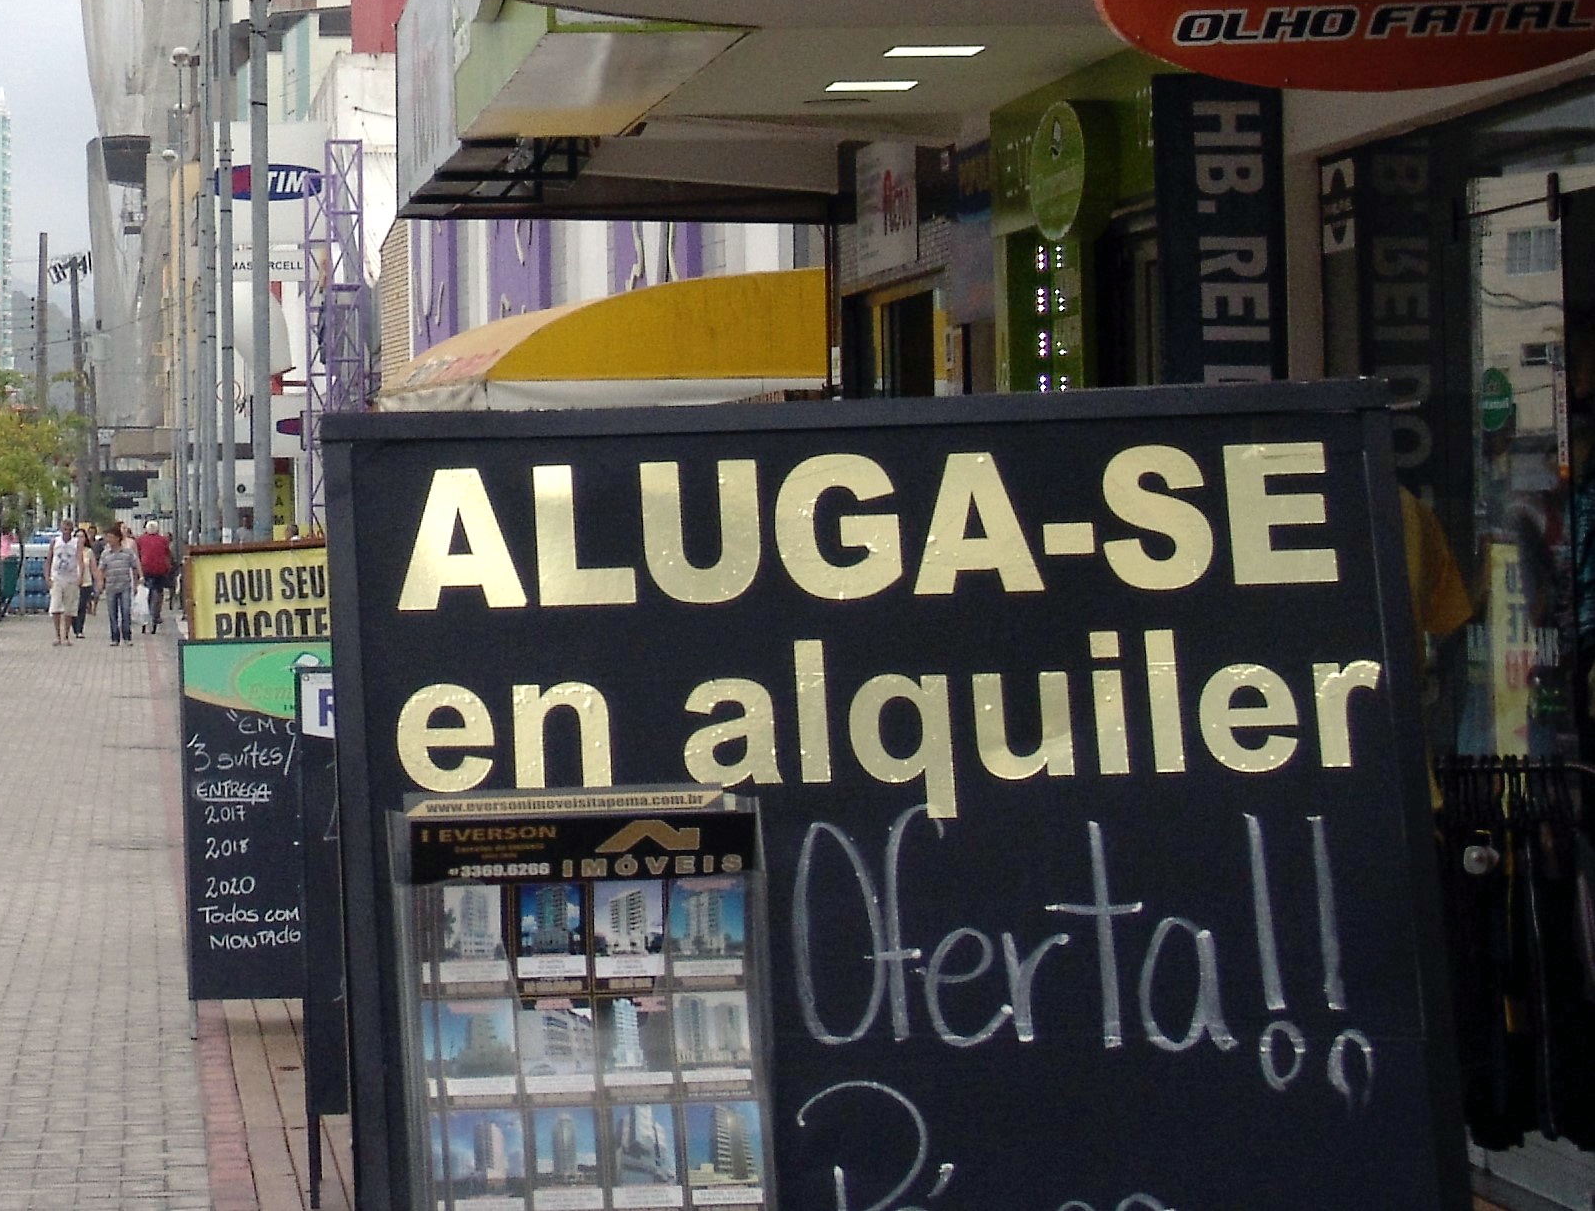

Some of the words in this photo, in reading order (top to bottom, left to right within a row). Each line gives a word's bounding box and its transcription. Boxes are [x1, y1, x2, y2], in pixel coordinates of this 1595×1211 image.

[1172, 5, 1360, 47] OLHO
[397, 441, 1341, 612] ALUGA-SE
[214, 568, 273, 606] AQUI
[279, 565, 326, 601] SEU
[396, 677, 613, 792] en
[681, 627, 1382, 819] alquiler
[196, 778, 272, 801] ENTREGA
[204, 804, 246, 825] 2017
[438, 824, 557, 843] EVERSON
[205, 837, 250, 860] 2018
[561, 853, 743, 878] IMÓVEIS
[205, 875, 255, 899] 2020
